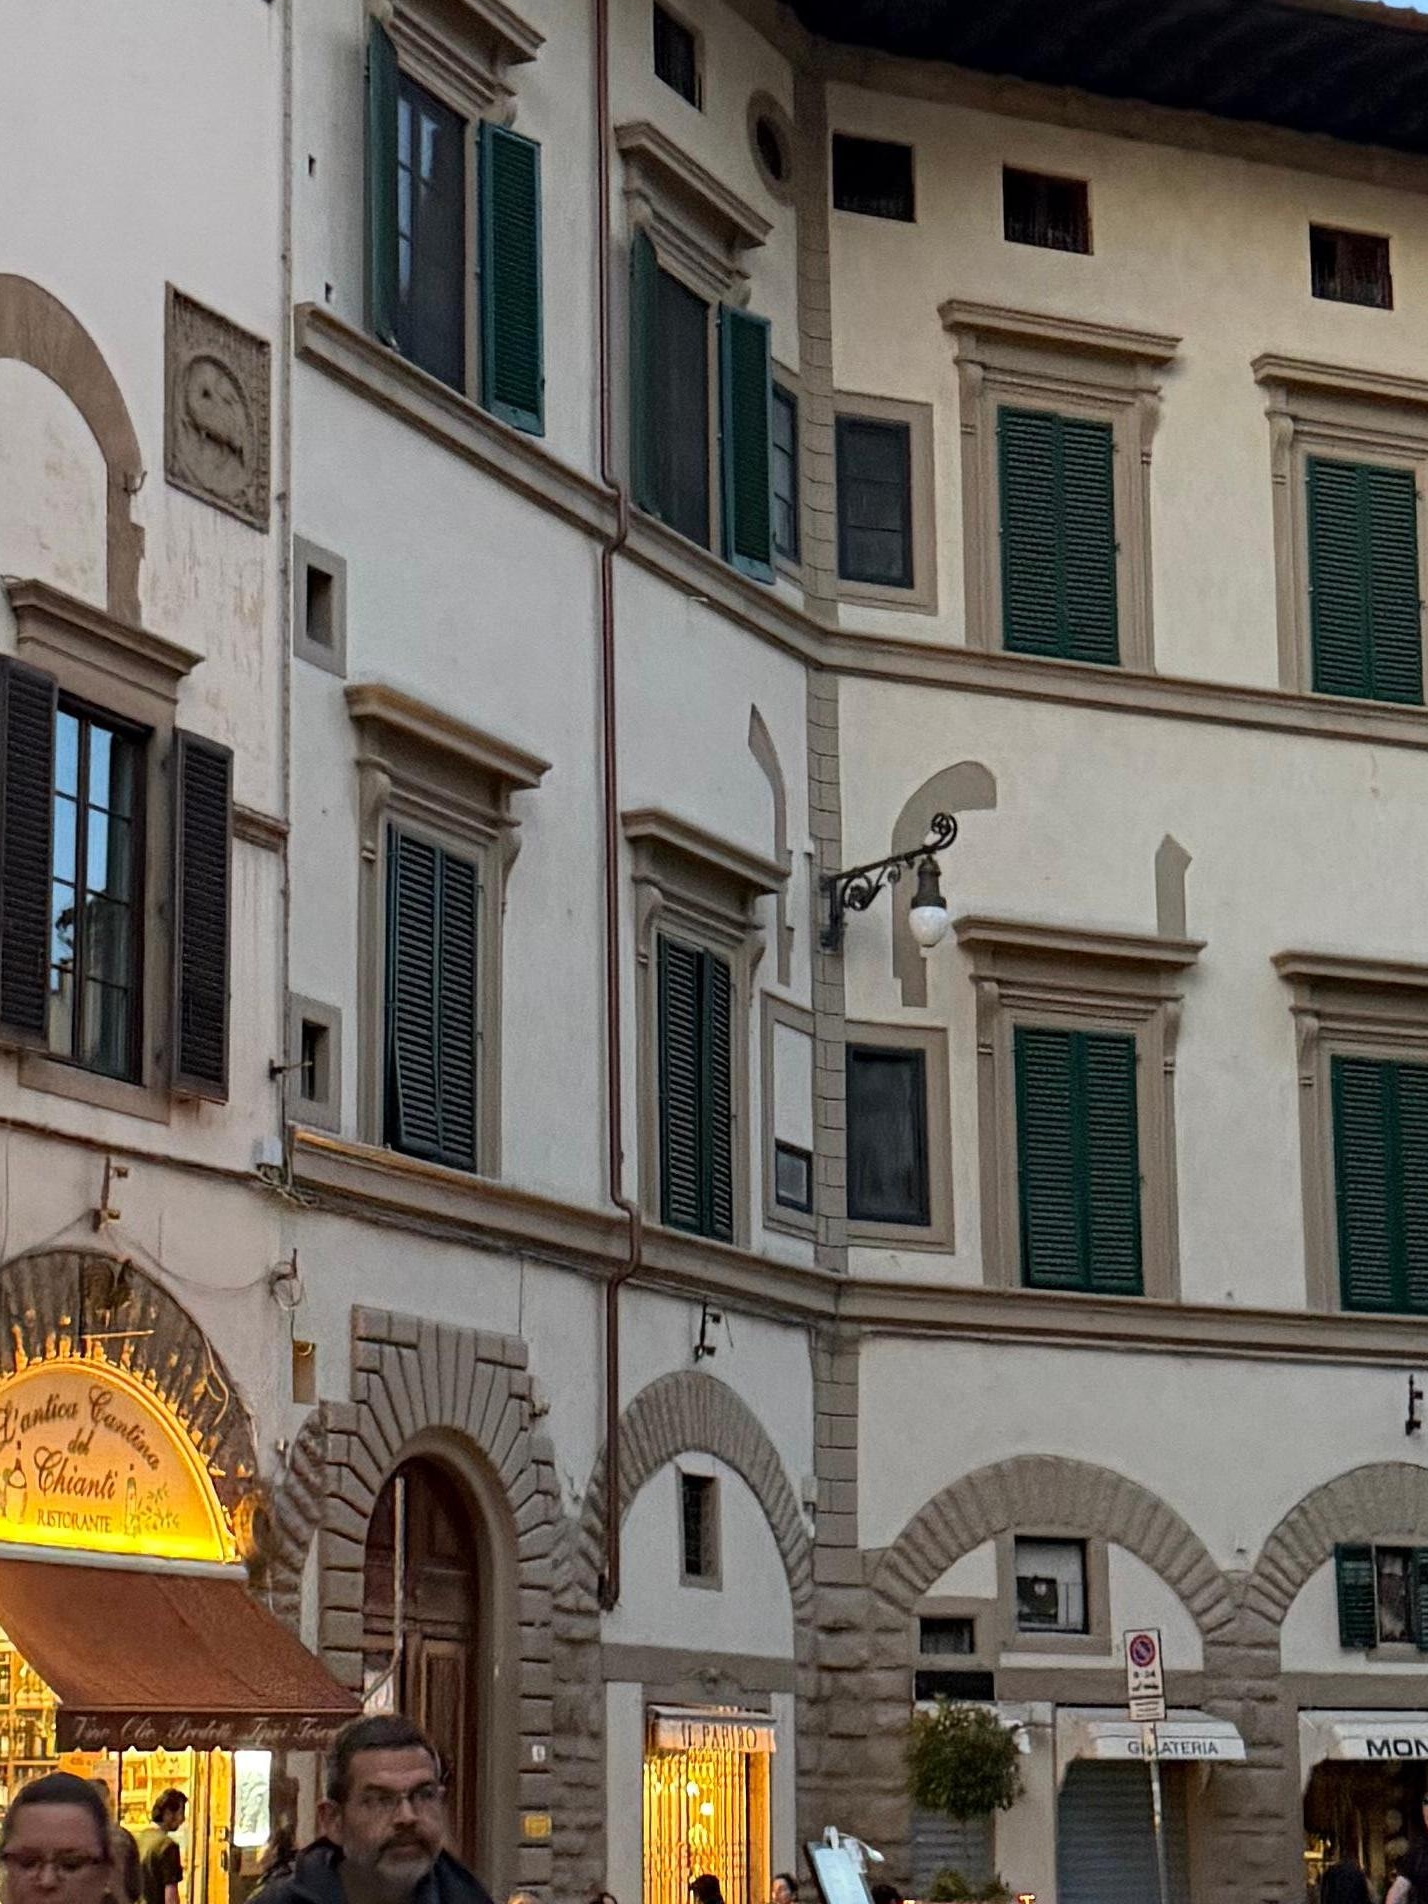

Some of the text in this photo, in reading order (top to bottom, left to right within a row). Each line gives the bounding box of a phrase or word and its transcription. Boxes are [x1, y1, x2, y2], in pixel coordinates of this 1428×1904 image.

[66, 1426, 96, 1456] del
[88, 1383, 162, 1472] Cantina
[33, 1445, 119, 1500] Chianti
[36, 1507, 114, 1534] RISTORANTE
